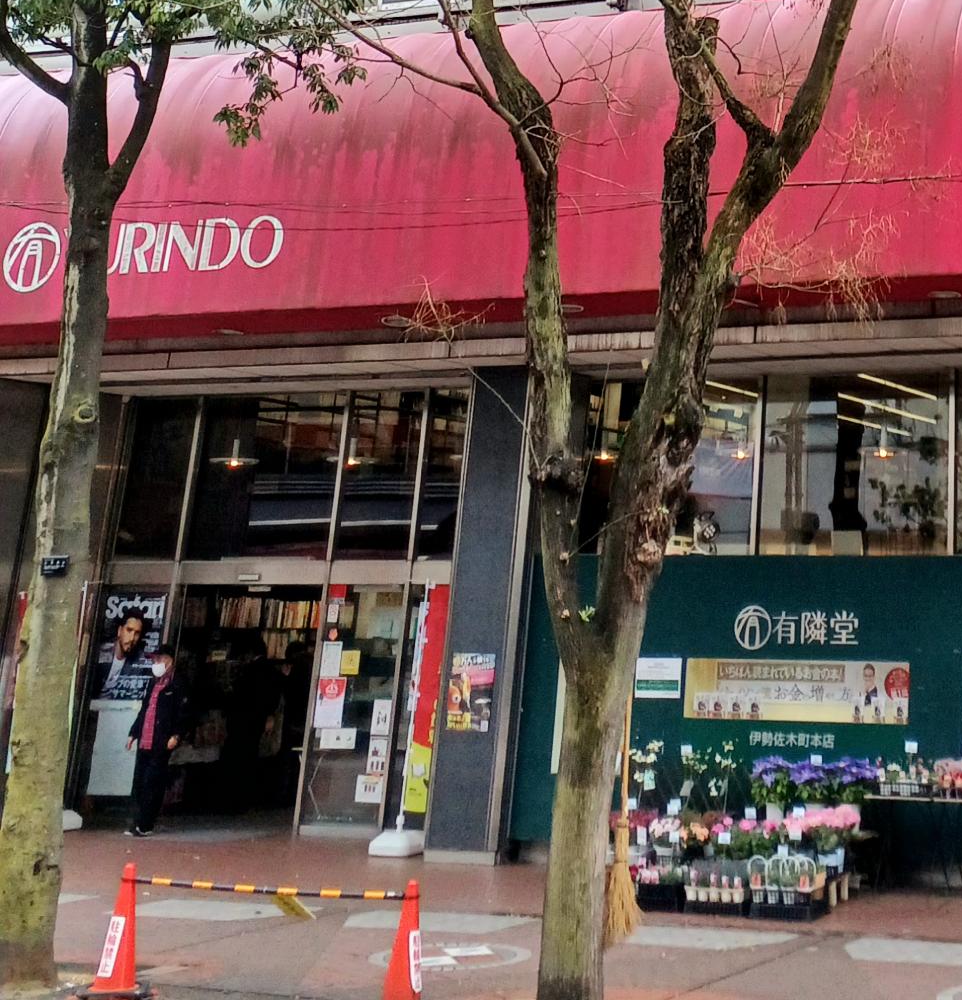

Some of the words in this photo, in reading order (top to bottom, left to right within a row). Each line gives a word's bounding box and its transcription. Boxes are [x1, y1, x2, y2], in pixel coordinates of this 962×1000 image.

[65, 215, 284, 275] RINDO
[771, 609, 859, 645] 有隣堂
[749, 730, 835, 750] 伊勢佐木町本店
